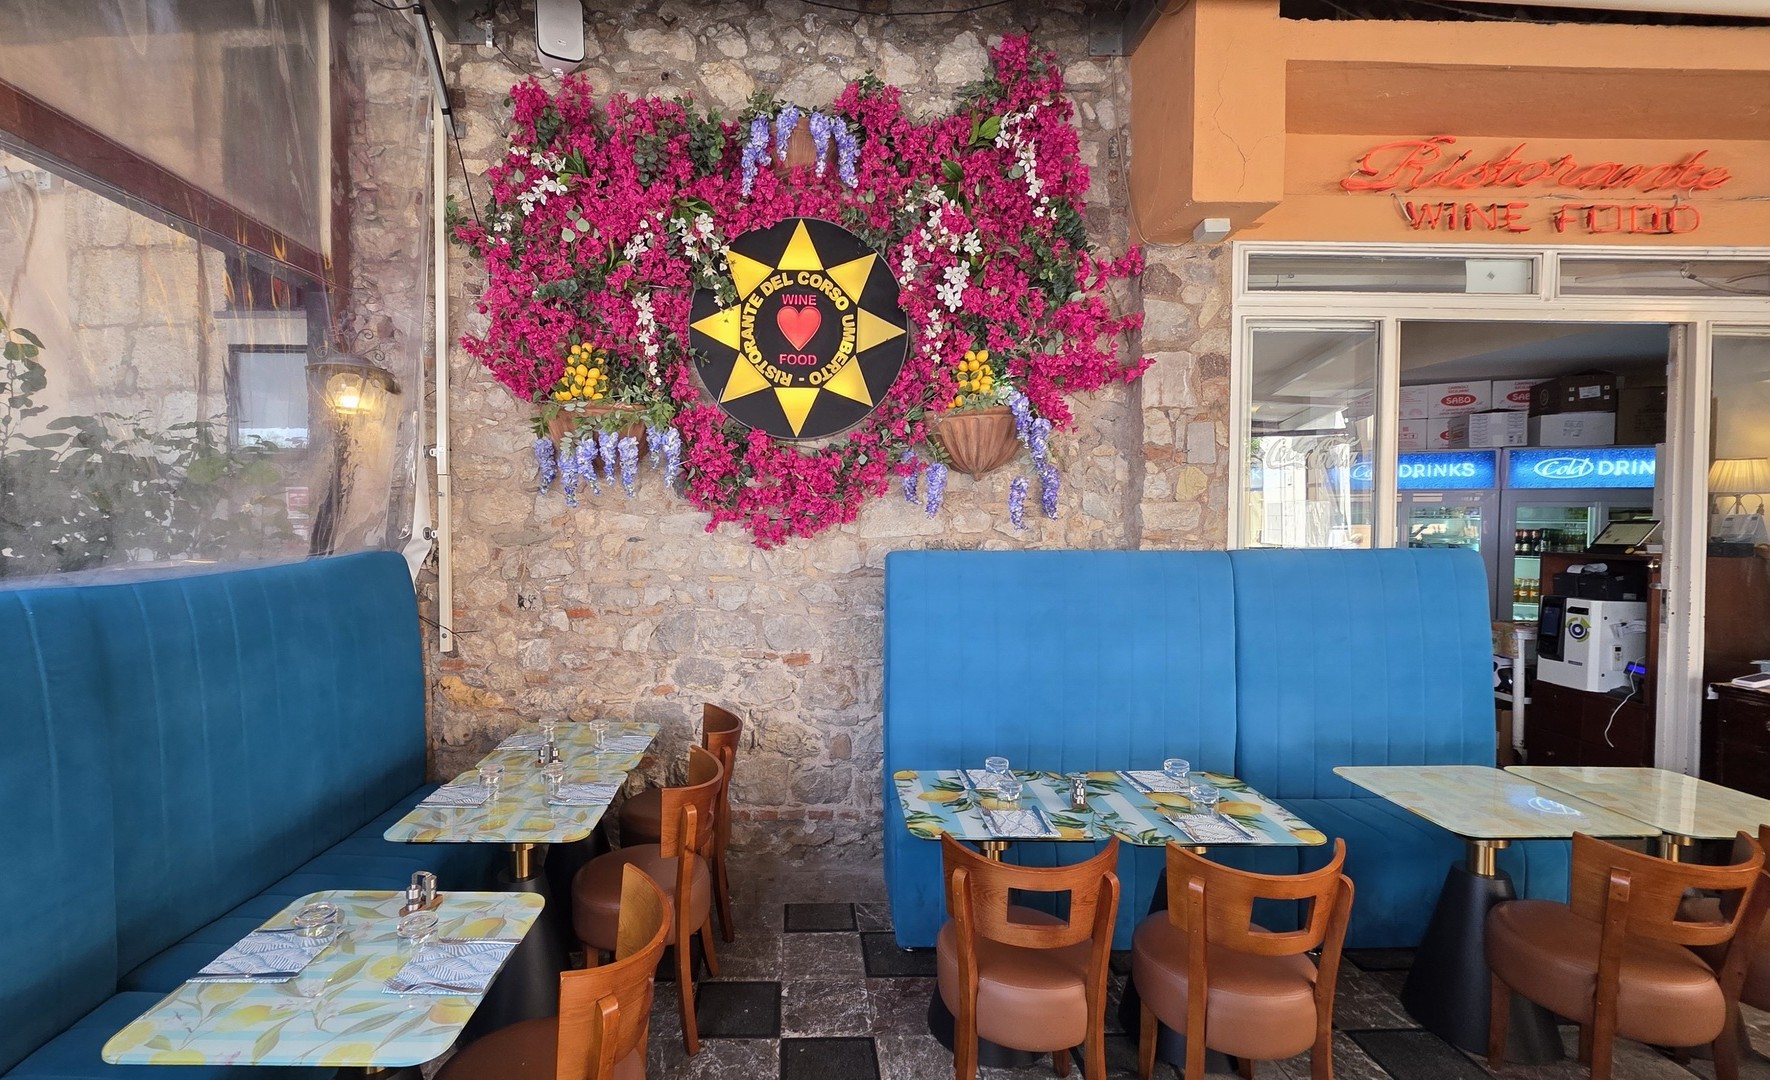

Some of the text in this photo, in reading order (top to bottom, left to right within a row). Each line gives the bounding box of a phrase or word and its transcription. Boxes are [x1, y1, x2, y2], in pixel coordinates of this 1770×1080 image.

[1339, 136, 1732, 193] Ristorante
[1405, 201, 1701, 234] WINE FOOD
[760, 272, 794, 297] DEL
[797, 271, 850, 311] CORSO
[782, 294, 817, 306] WINE
[741, 293, 793, 387] RISTORANTE
[809, 314, 856, 385] UMBERTO
[779, 354, 817, 365] FOOD
[1446, 396, 1471, 405] SABO
[1399, 463, 1475, 478] DRINKS
[1542, 458, 1656, 476] Cold DRIN
